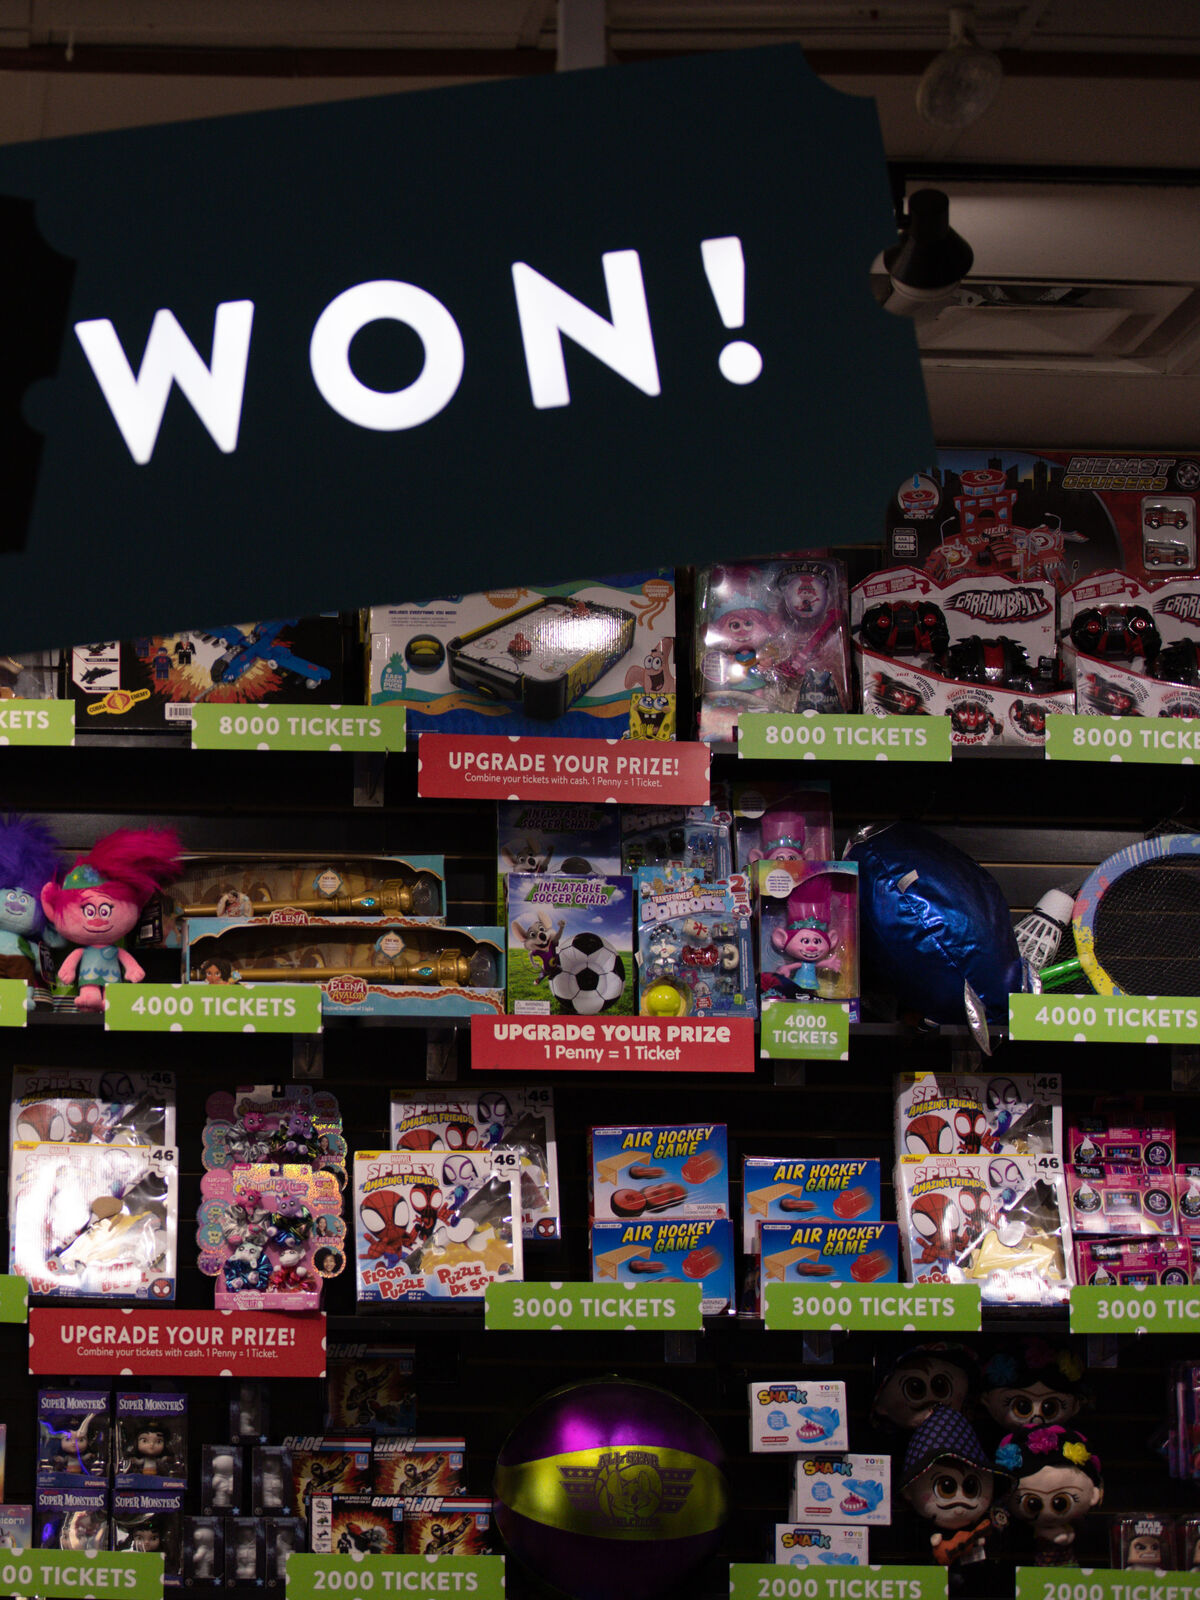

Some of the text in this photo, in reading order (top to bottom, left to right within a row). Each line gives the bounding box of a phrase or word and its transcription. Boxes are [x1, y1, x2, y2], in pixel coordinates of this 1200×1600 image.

[74, 235, 764, 465] WON!
[1066, 457, 1175, 475] DIECAST
[1062, 475, 1168, 491] CRUISERS
[130, 689, 150, 702] ENEMY
[219, 716, 381, 736] 8000 TICKETS
[766, 726, 927, 746] 8000 TICKETS
[1073, 728, 1200, 749] 8000 TICKE
[449, 752, 678, 776] UPGRADE YOUR PRIZE!
[465, 772, 662, 788] Combine your tickets with cash. Penny Ticket.
[538, 882, 601, 893] INFLATABLE
[532, 892, 608, 904] SOCCER CHAIR
[330, 981, 364, 993] ELENA
[131, 996, 296, 1017] 4000 TICKETS
[785, 1014, 826, 1029] 4000
[1035, 1006, 1198, 1028] 4000 TICKETS
[601, 1025, 661, 1042] YOUR
[773, 1030, 838, 1045] TICKETS
[544, 1045, 681, 1063] 1 Penny 1 Ticket
[622, 1126, 715, 1149] AIR HOCKEY
[653, 1140, 698, 1159] GAME
[494, 1154, 516, 1166] 46
[366, 1163, 436, 1179] SPIDEY
[363, 1173, 440, 1192] AMAZING FRIENDS
[361, 1265, 482, 1285] FLOOR PUZZLE
[379, 1278, 425, 1299] PUZZLE
[449, 1283, 466, 1297] DE
[513, 1298, 675, 1317] 3000 TICKETS
[793, 1297, 955, 1316] 3000 TICKETS
[1097, 1300, 1156, 1319] 3000
[61, 1325, 295, 1346] UPGRADE YOUR PRIZE!
[77, 1346, 278, 1360] Combine your tickets with cash. Penny Ticket.
[41, 1396, 107, 1411] SUPER MONSTERS
[756, 1388, 808, 1405] SHARK
[1134, 1526, 1164, 1536] WARS
[1137, 1520, 1162, 1529] STAR
[40, 1566, 136, 1588] TICKETS
[314, 1570, 478, 1591] 2000 TICKETS
[758, 1578, 921, 1599] 2000 TICKETS
[1043, 1583, 1103, 1600] 2000
